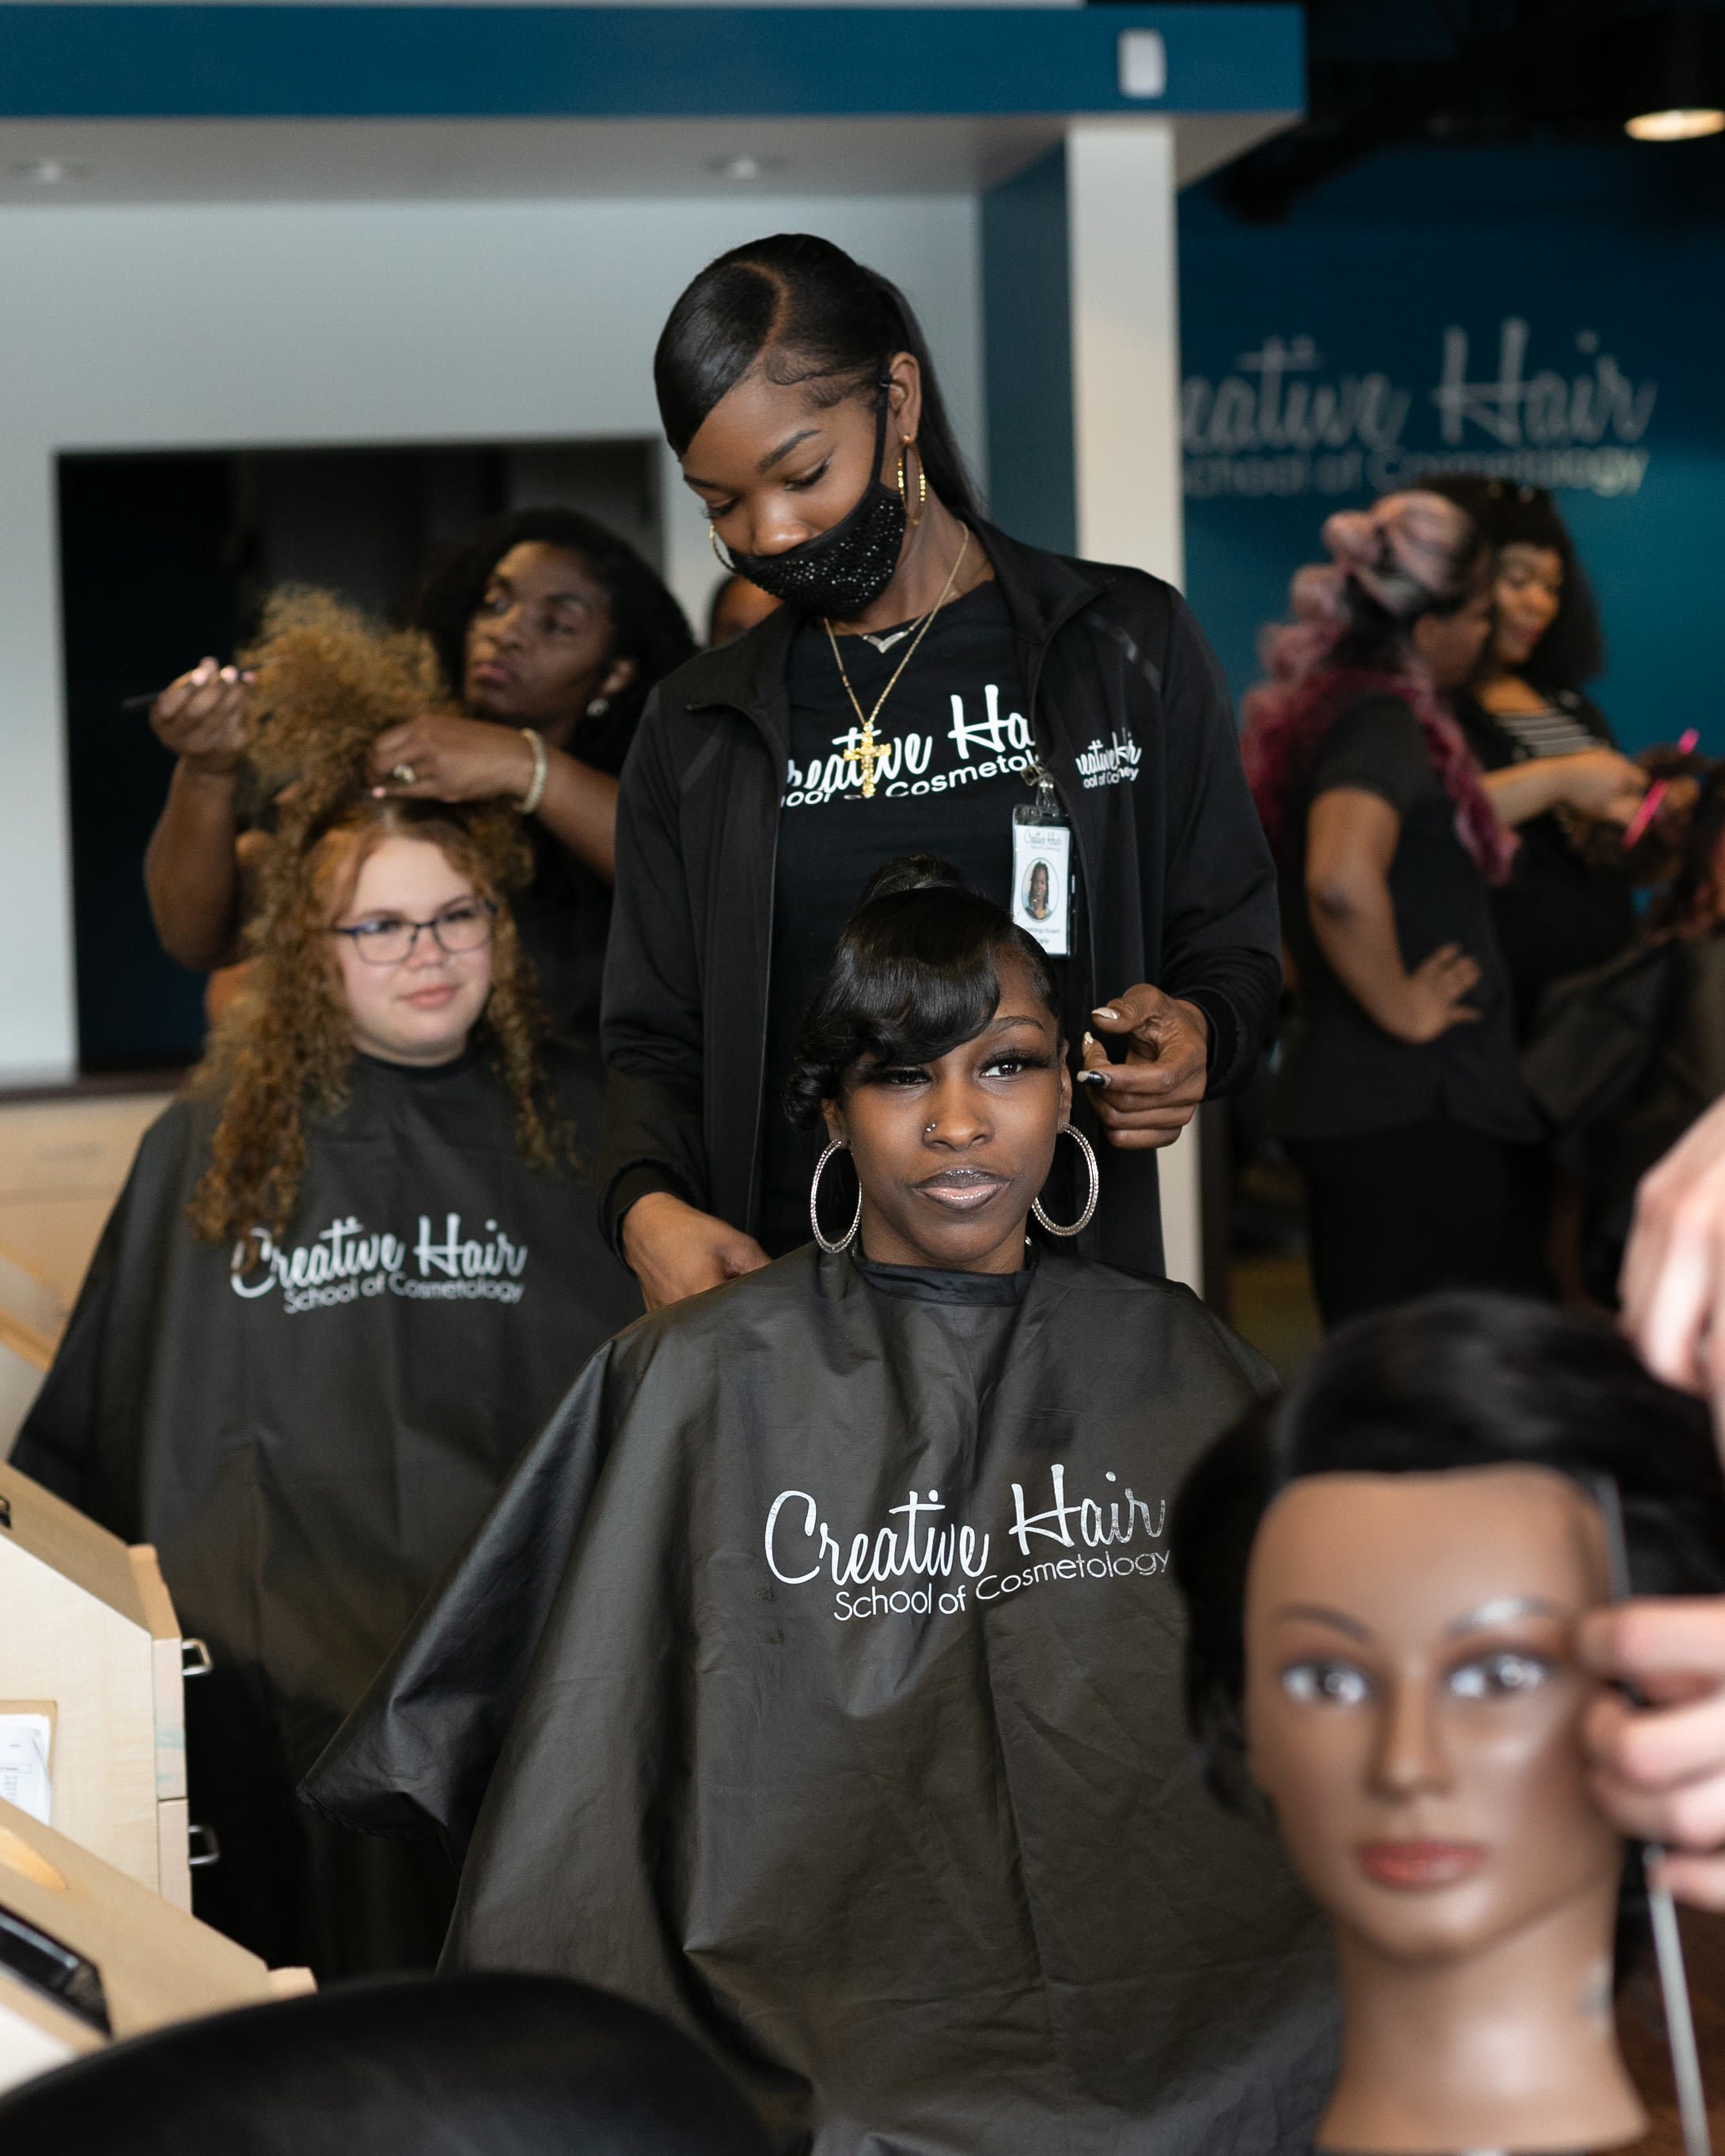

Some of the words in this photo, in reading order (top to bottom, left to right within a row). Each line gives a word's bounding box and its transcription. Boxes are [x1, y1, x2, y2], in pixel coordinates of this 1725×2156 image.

[1182, 335, 1412, 454] eative
[1430, 318, 1658, 446] Hair
[231, 1214, 405, 1299] Creative
[412, 1211, 529, 1278] Hair
[283, 1277, 358, 1314] School
[361, 1271, 386, 1298] of
[388, 1271, 525, 1305] Cosmetology
[764, 1489, 990, 1586] Creative
[1008, 1463, 1166, 1555] Hair
[833, 1582, 932, 1621] School
[938, 1585, 966, 1615] of
[975, 1549, 1171, 1601] Cosmetology
